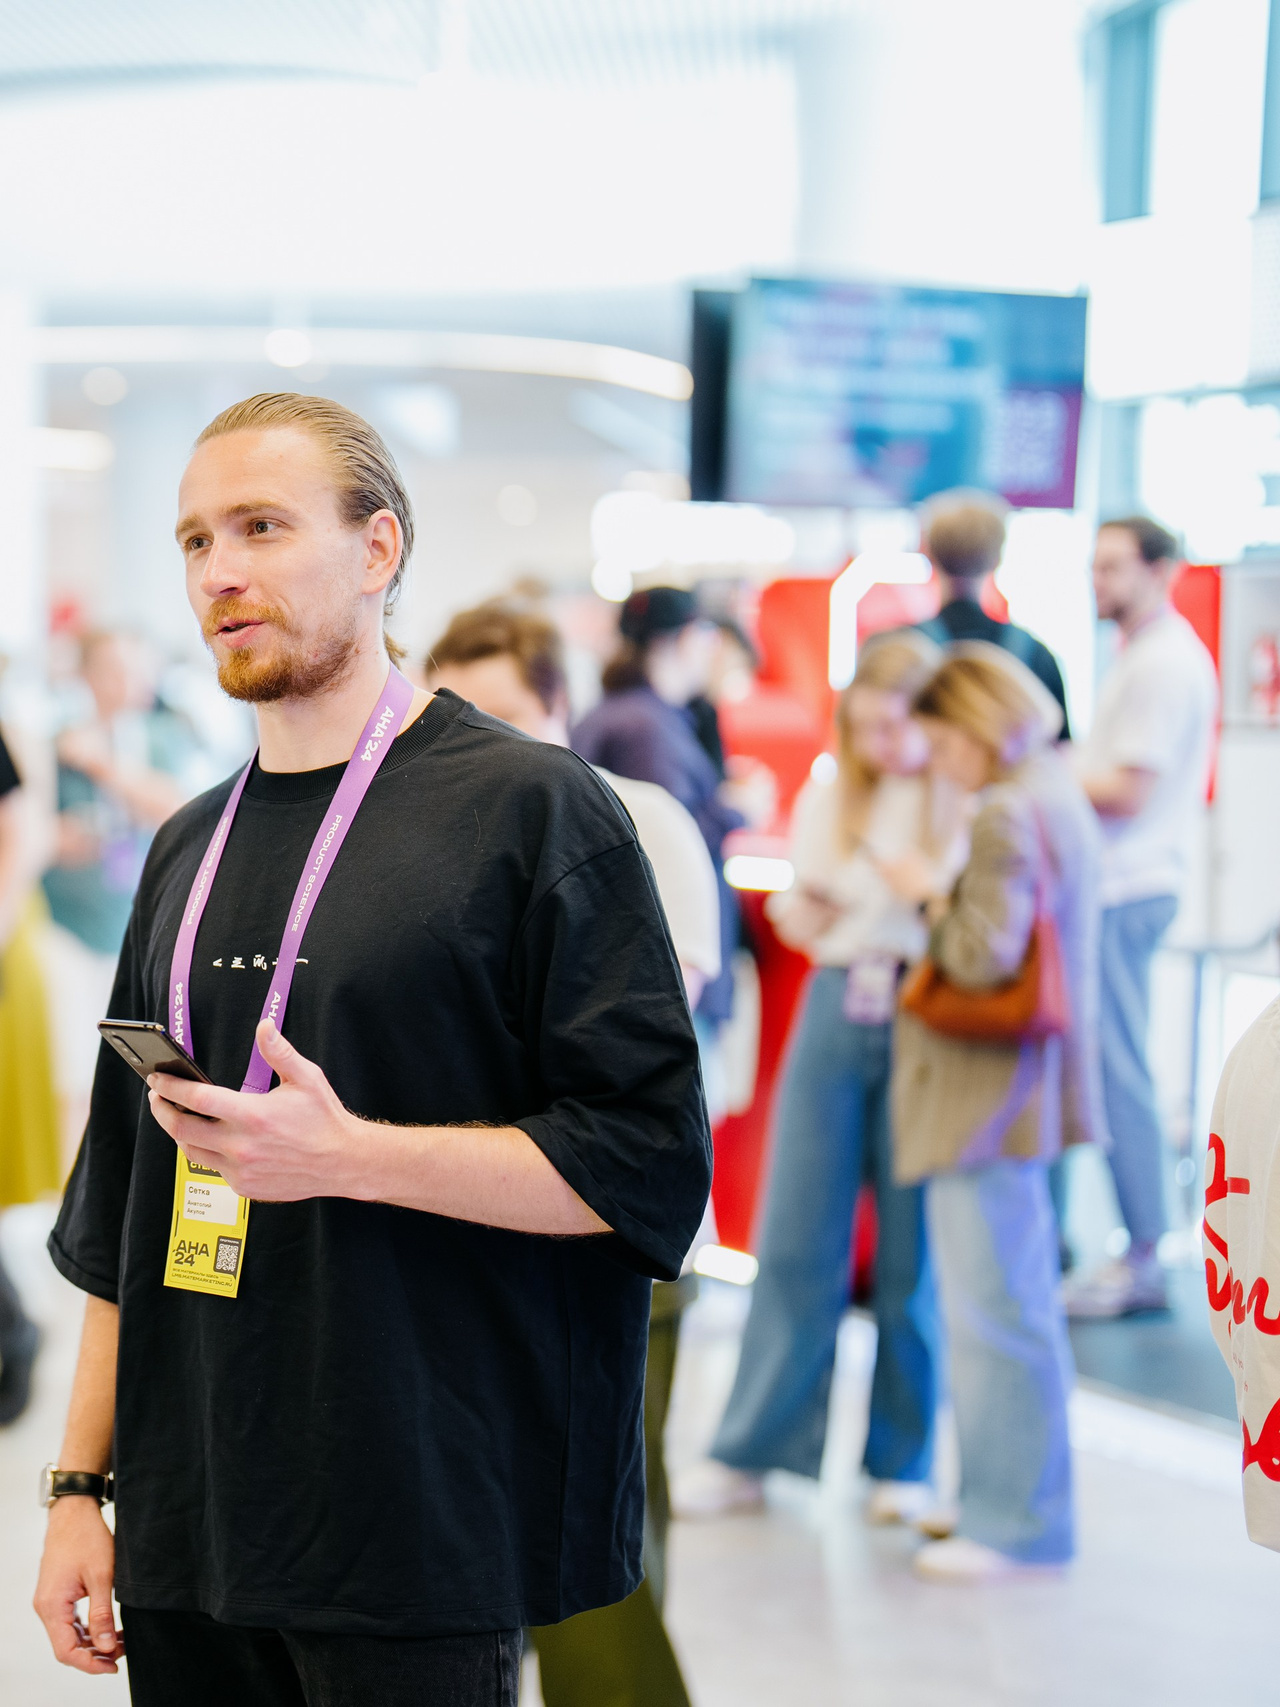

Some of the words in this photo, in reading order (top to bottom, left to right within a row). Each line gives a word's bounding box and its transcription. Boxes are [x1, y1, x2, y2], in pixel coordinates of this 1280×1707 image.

[361, 705, 394, 761] AHA'24
[186, 869, 209, 925] PRODUCT
[206, 816, 229, 868] SCIENCE
[313, 814, 343, 874] PRODUCT
[291, 874, 316, 932] SCIENCE
[174, 982, 185, 1045] AHA'24
[188, 1186, 210, 1196] Сетка
[176, 1240, 209, 1257] AHA
